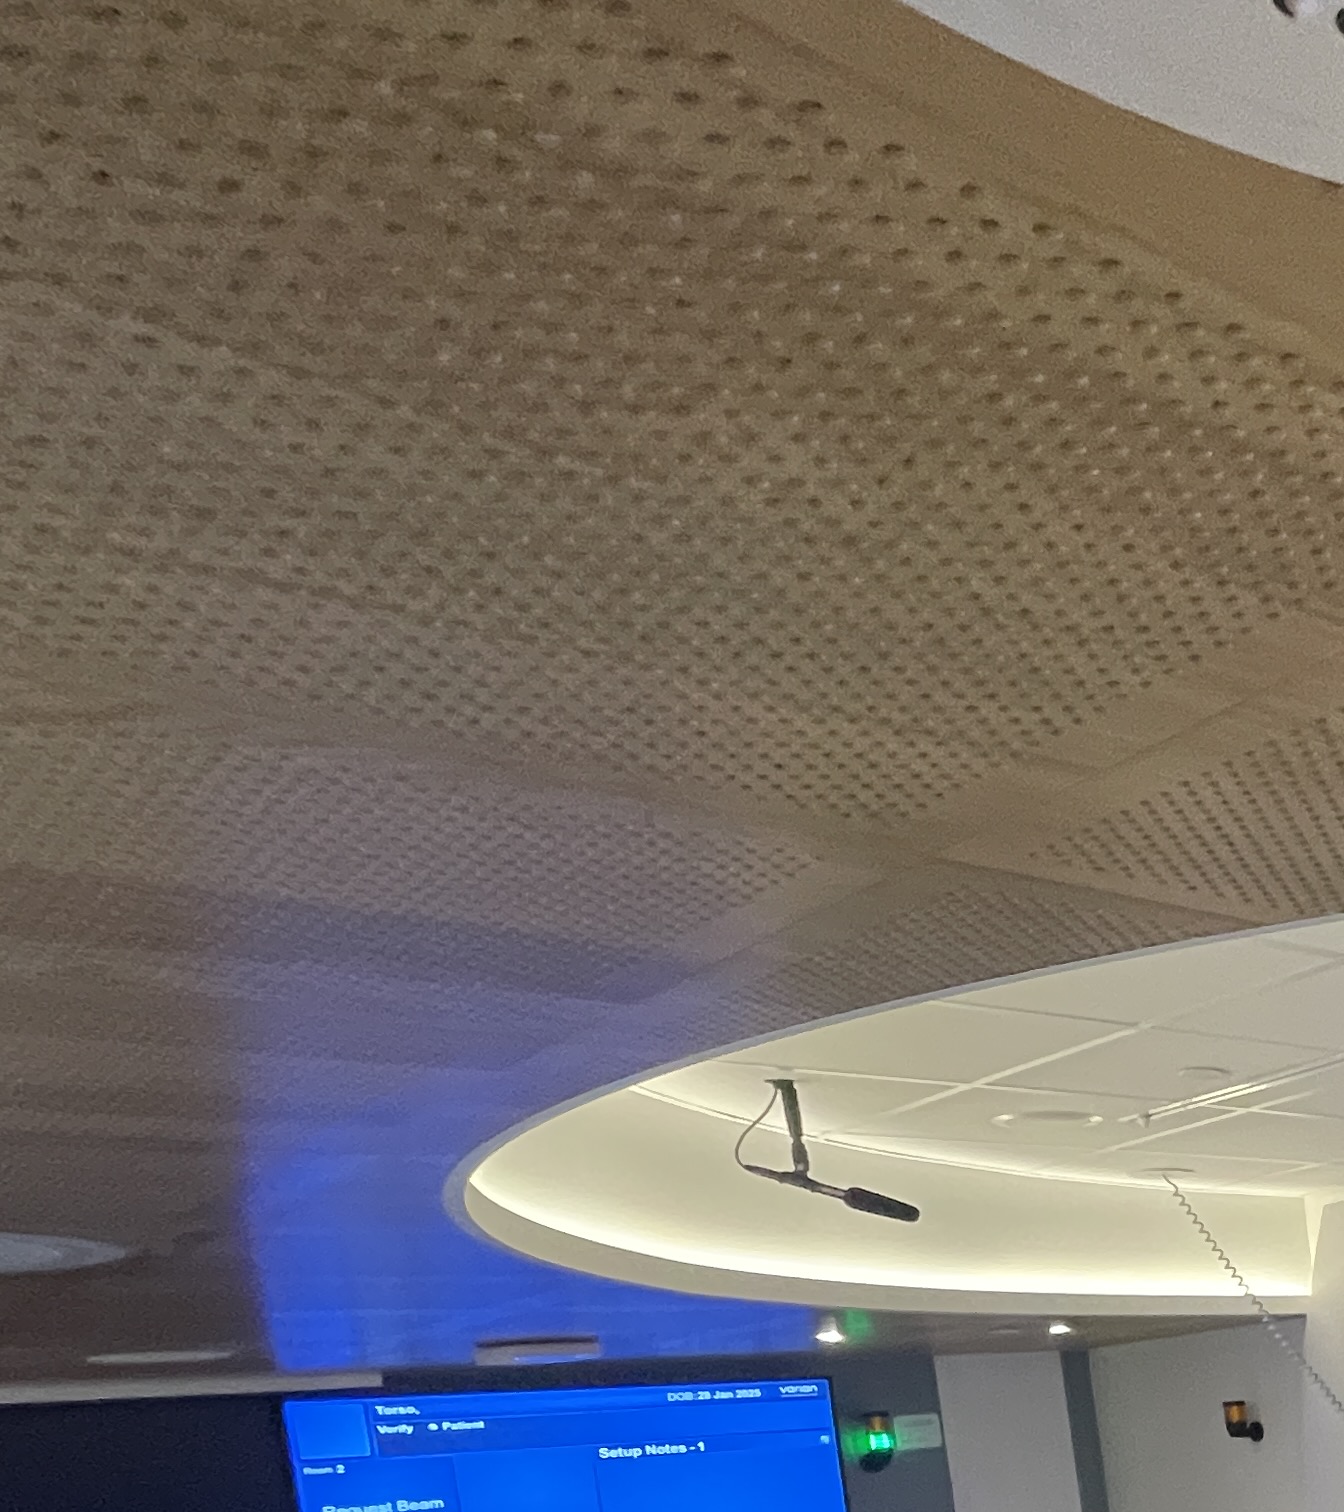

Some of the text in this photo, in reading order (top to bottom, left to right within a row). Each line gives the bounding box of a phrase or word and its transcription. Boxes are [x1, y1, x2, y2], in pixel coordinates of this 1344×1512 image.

[598, 1446, 643, 1459] Setup
[645, 1443, 688, 1456] Notes
[396, 1499, 445, 1512] Beam
